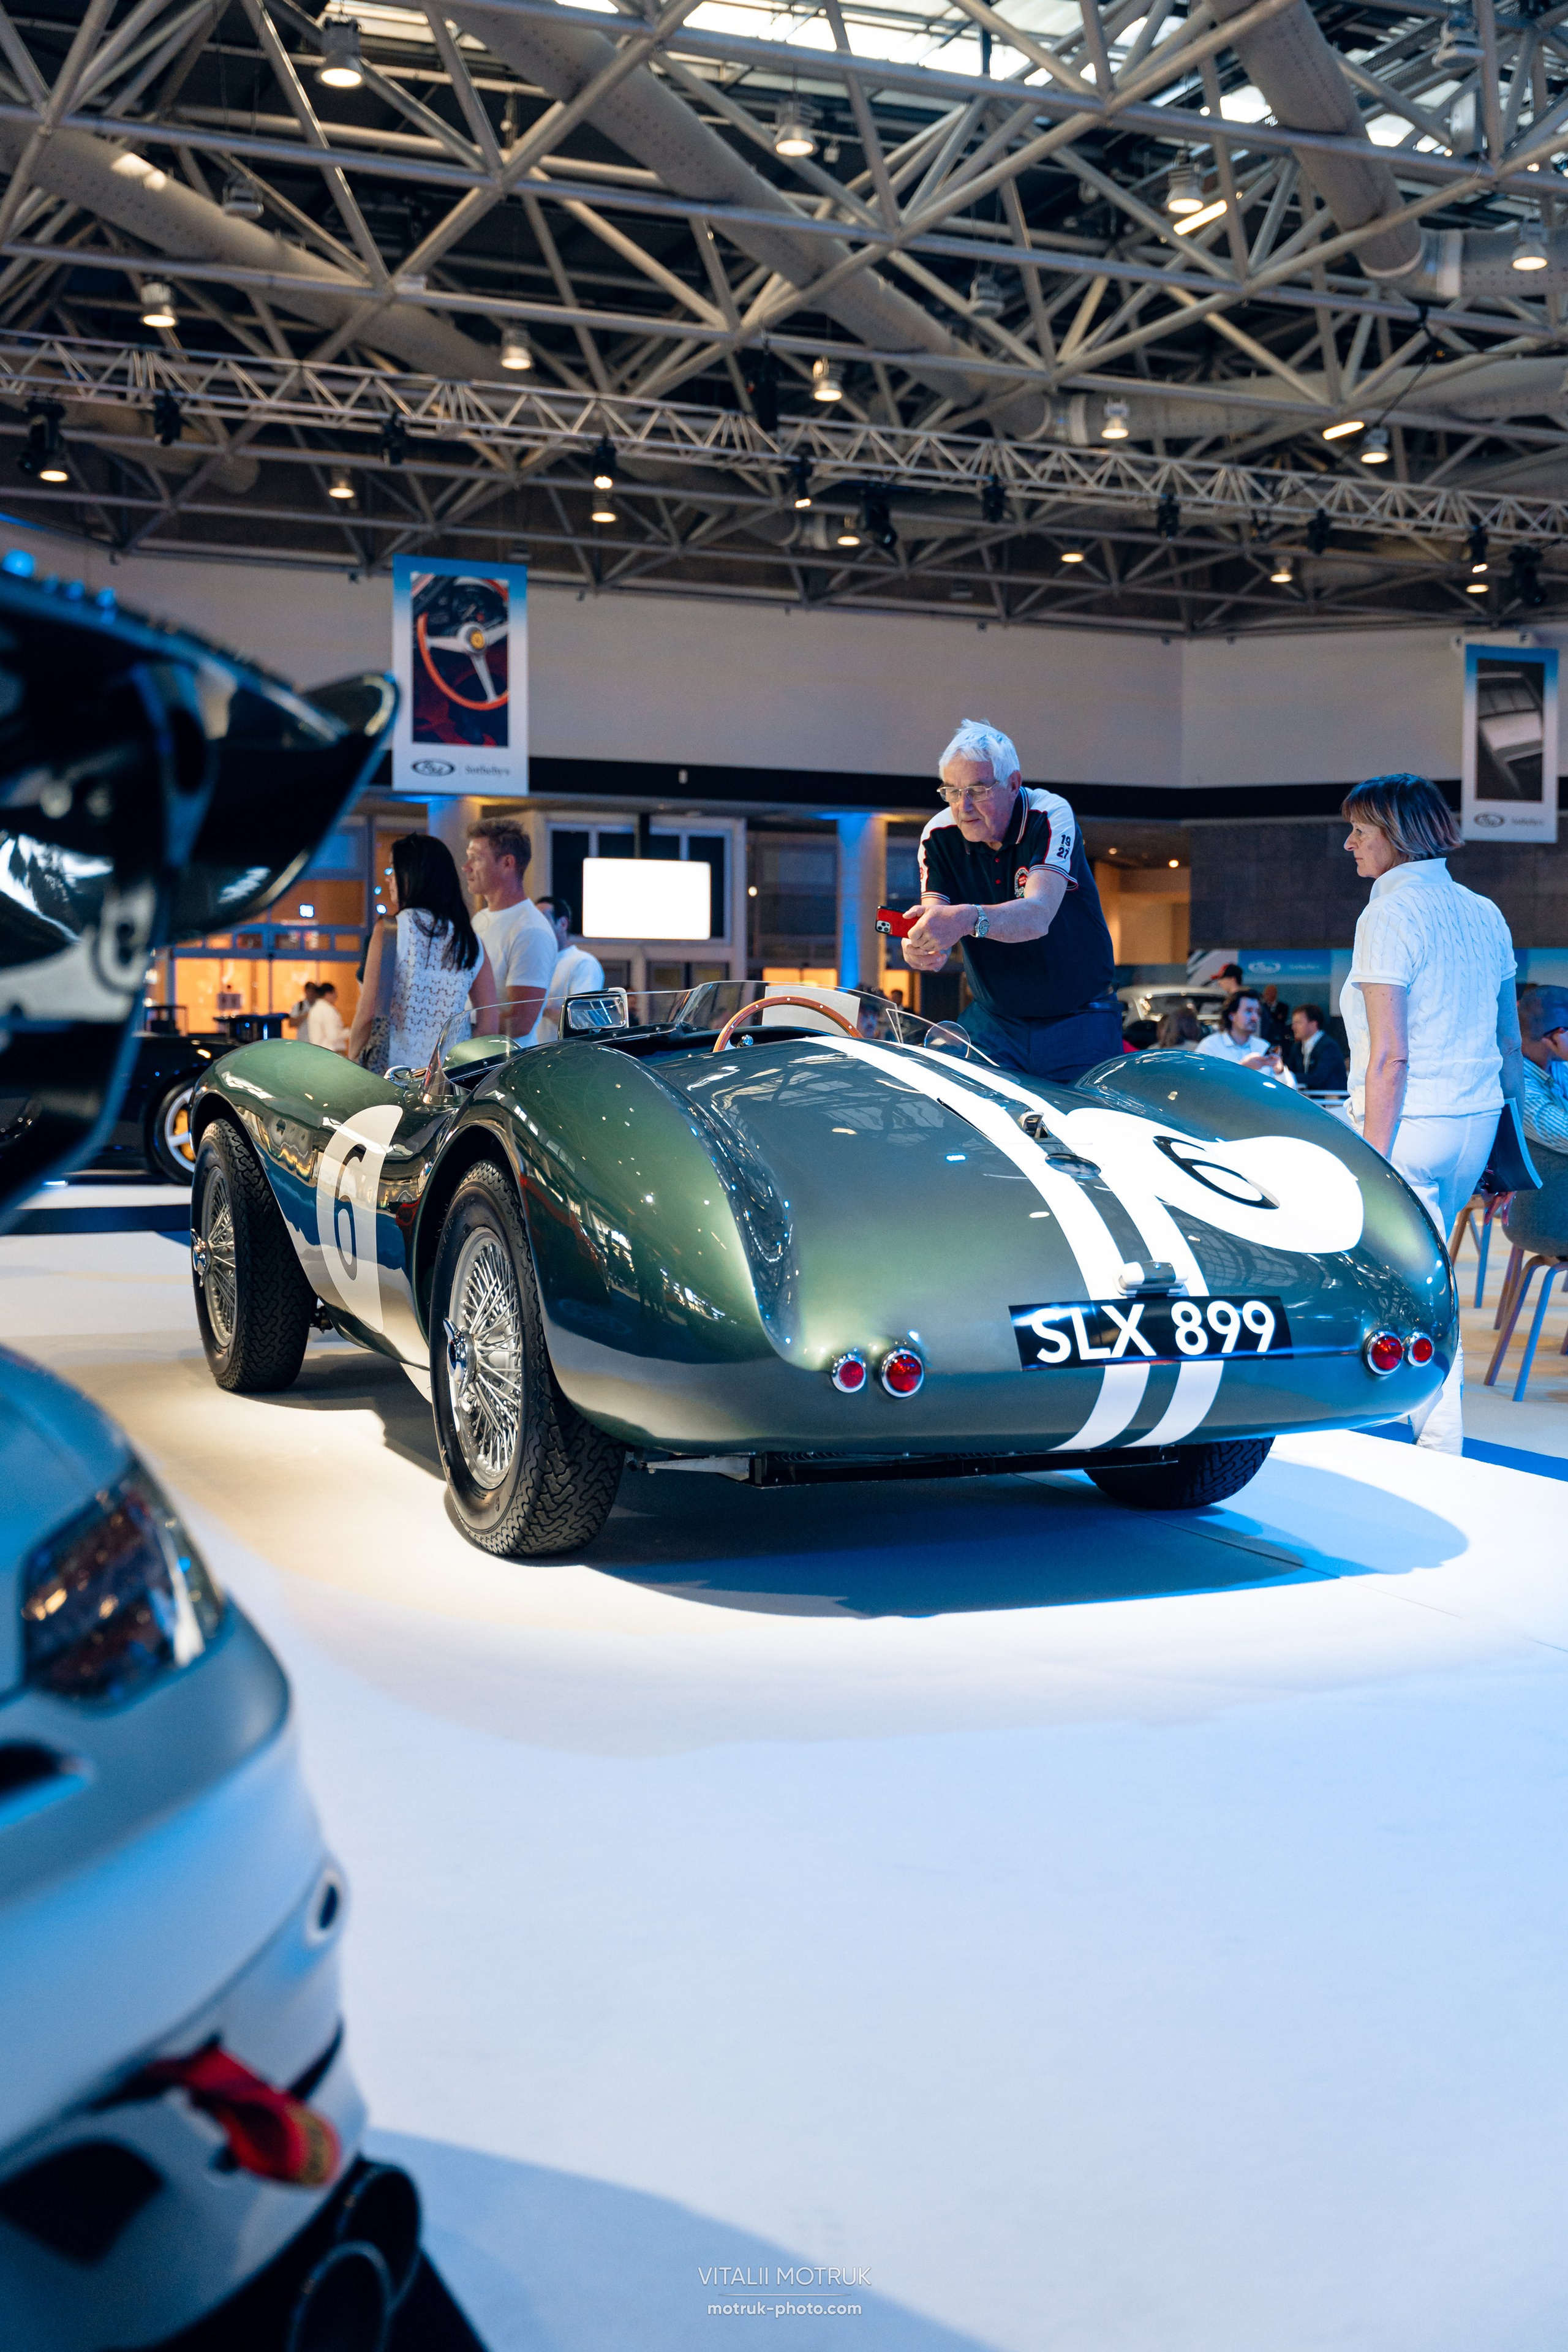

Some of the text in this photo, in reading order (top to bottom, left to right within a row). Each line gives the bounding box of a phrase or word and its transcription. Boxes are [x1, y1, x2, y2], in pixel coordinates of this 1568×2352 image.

[1057, 846, 1070, 859] 27
[1061, 834, 1071, 847] 19
[1153, 1136, 1280, 1210] 6
[334, 1143, 365, 1281] 6
[1031, 1300, 1276, 1363] SLX 899
